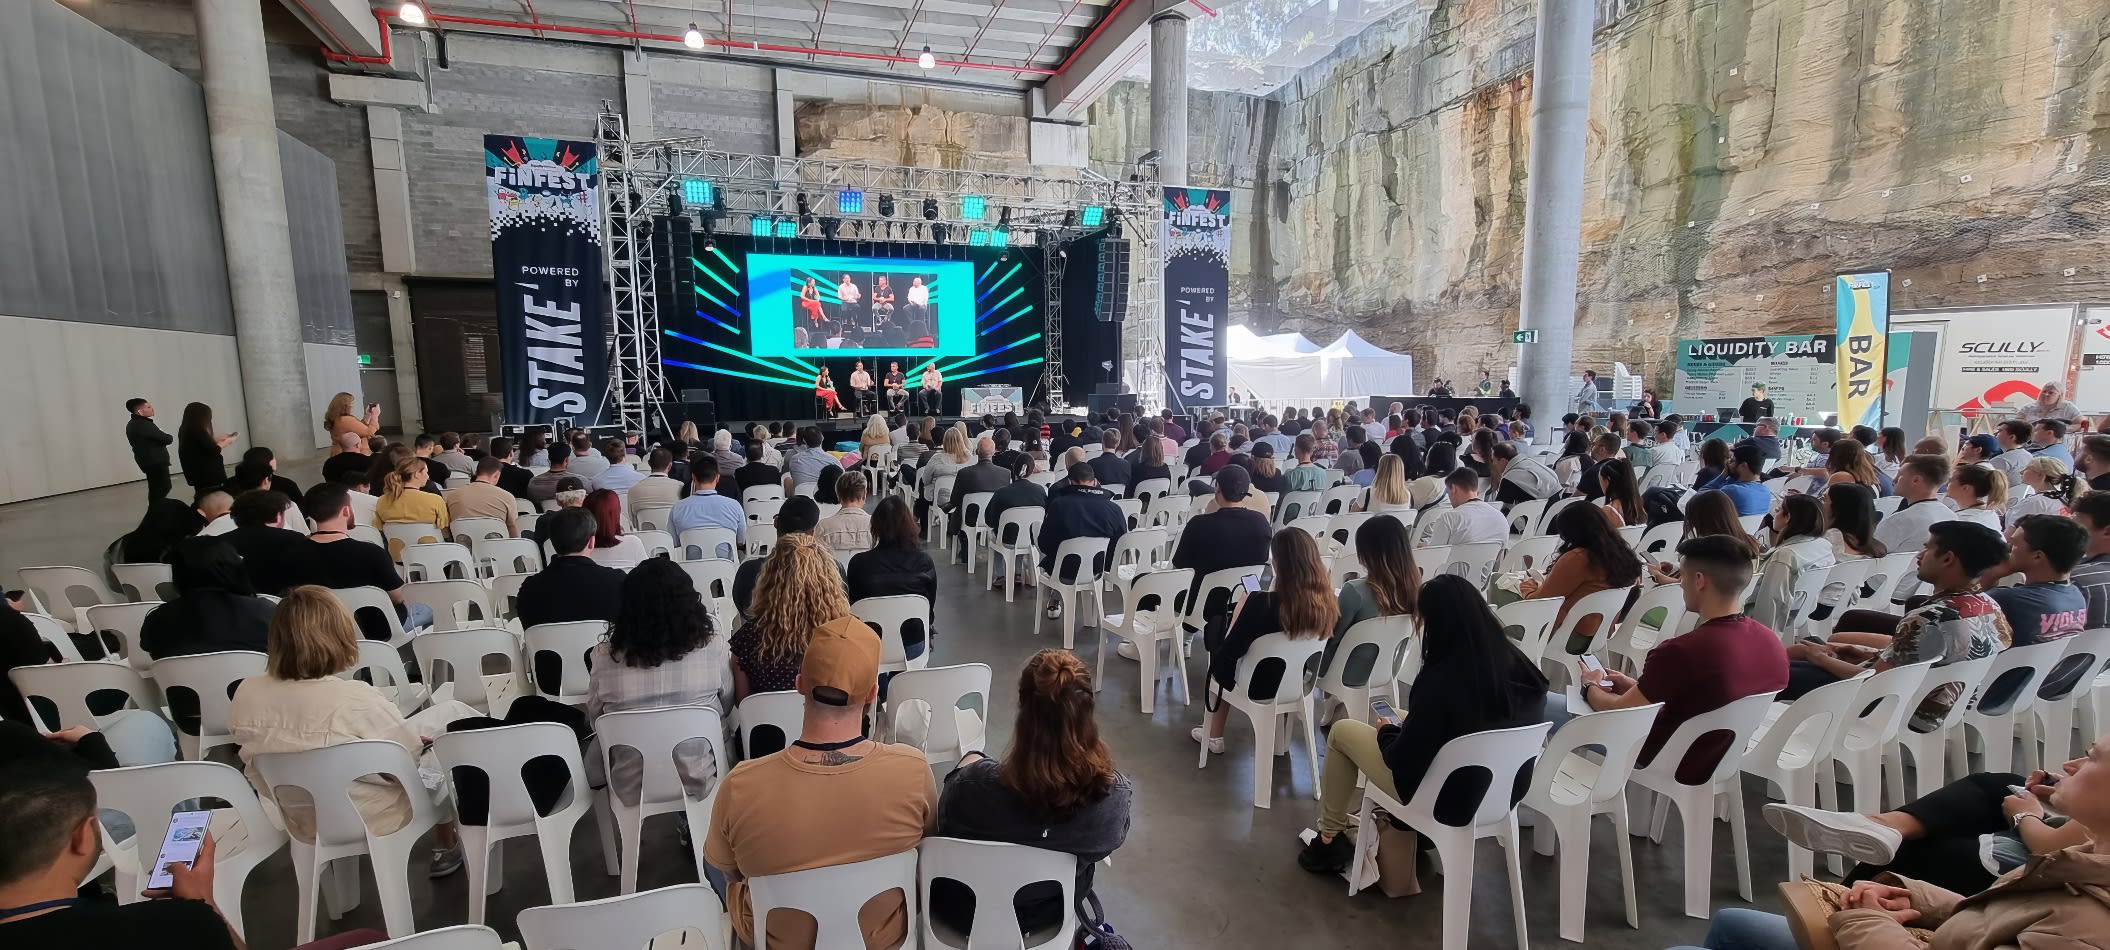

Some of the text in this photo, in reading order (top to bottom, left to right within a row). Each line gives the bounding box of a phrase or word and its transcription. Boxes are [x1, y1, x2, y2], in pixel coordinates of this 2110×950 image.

[522, 265, 579, 276] POWERED
[565, 278, 579, 288] BY
[1180, 286, 1215, 295] POWERED
[1688, 340, 1827, 356] LIQUIDITY BAR
[1958, 342, 2045, 353] SCULLY
[1847, 335, 1873, 400] BAR
